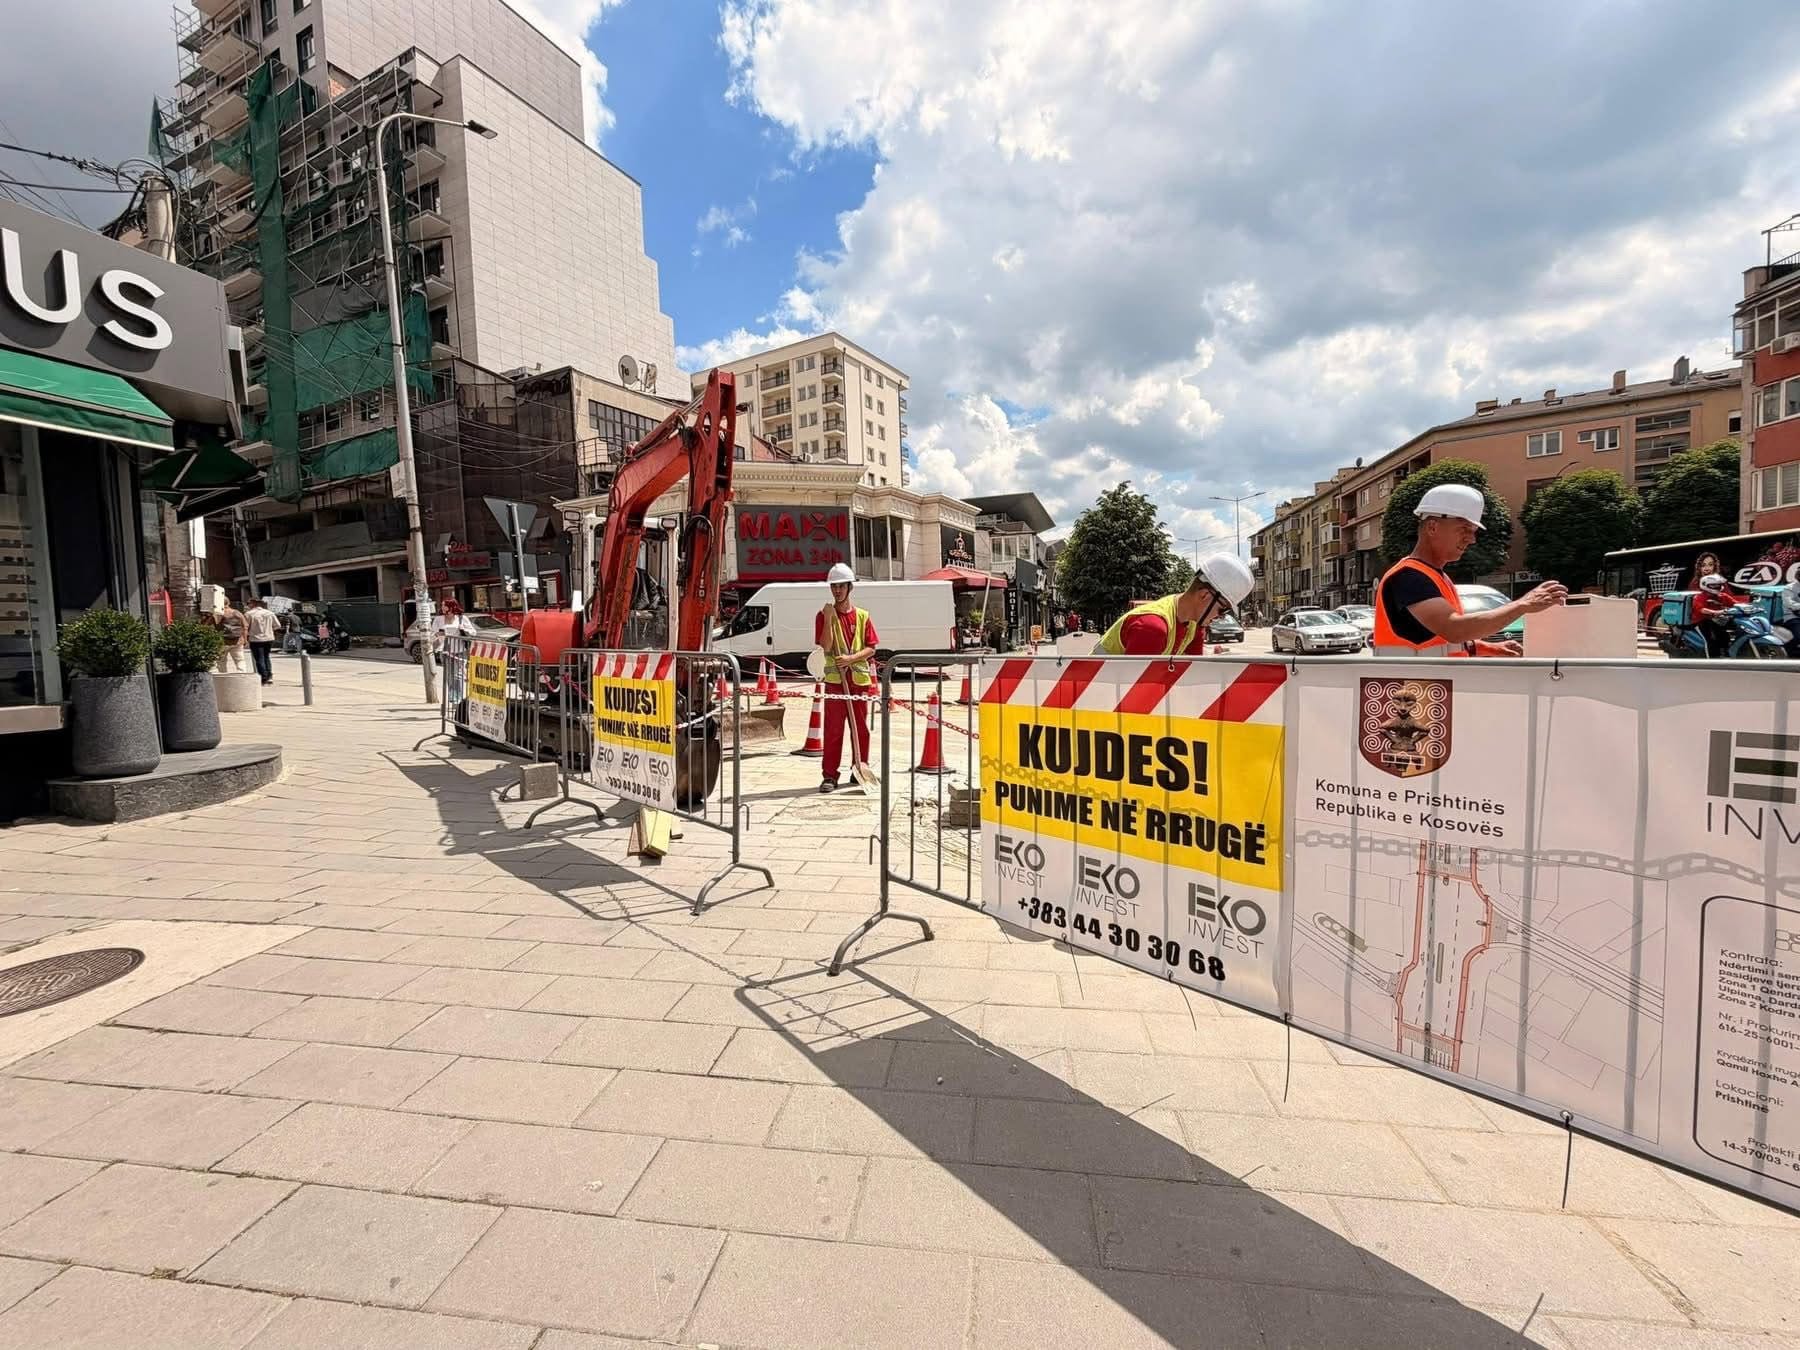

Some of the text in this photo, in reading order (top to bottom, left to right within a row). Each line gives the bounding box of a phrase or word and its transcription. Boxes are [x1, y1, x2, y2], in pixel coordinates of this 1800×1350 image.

[1, 227, 173, 350] US
[746, 547, 805, 565] ZONA
[604, 686, 657, 716] KUJDES!
[598, 717, 671, 744] PUNIME NË RRUGË
[649, 758, 669, 777] EKO
[1018, 723, 1209, 796] KUJDES!
[632, 782, 641, 795] 30
[642, 785, 651, 798] 30
[1315, 778, 1505, 816] Komuna e Prishtinës
[995, 780, 1266, 866] PUNIME NË RRUGË
[1315, 798, 1504, 838] Republika e Kosovës
[994, 834, 1267, 937] EKO EKO EKO
[994, 865, 1265, 959] INVEST INVEST INVEST
[1018, 897, 1226, 982] +383 44 30 30 68
[1720, 948, 1783, 968] Kontrata:
[1718, 976, 1746, 989] Zona
[1718, 992, 1746, 1006] Zona
[1760, 1003, 1795, 1018] Kodra
[1719, 1011, 1737, 1023] Nr.
[1716, 1058, 1748, 1073] Qamil
[1752, 1067, 1787, 1084] Hoxha
[1715, 1079, 1784, 1107] Lokacioni:
[1715, 1090, 1769, 1114] Prishtinë
[1722, 1140, 1781, 1165] 14-370/03
[1748, 1137, 1794, 1159] Projekti
